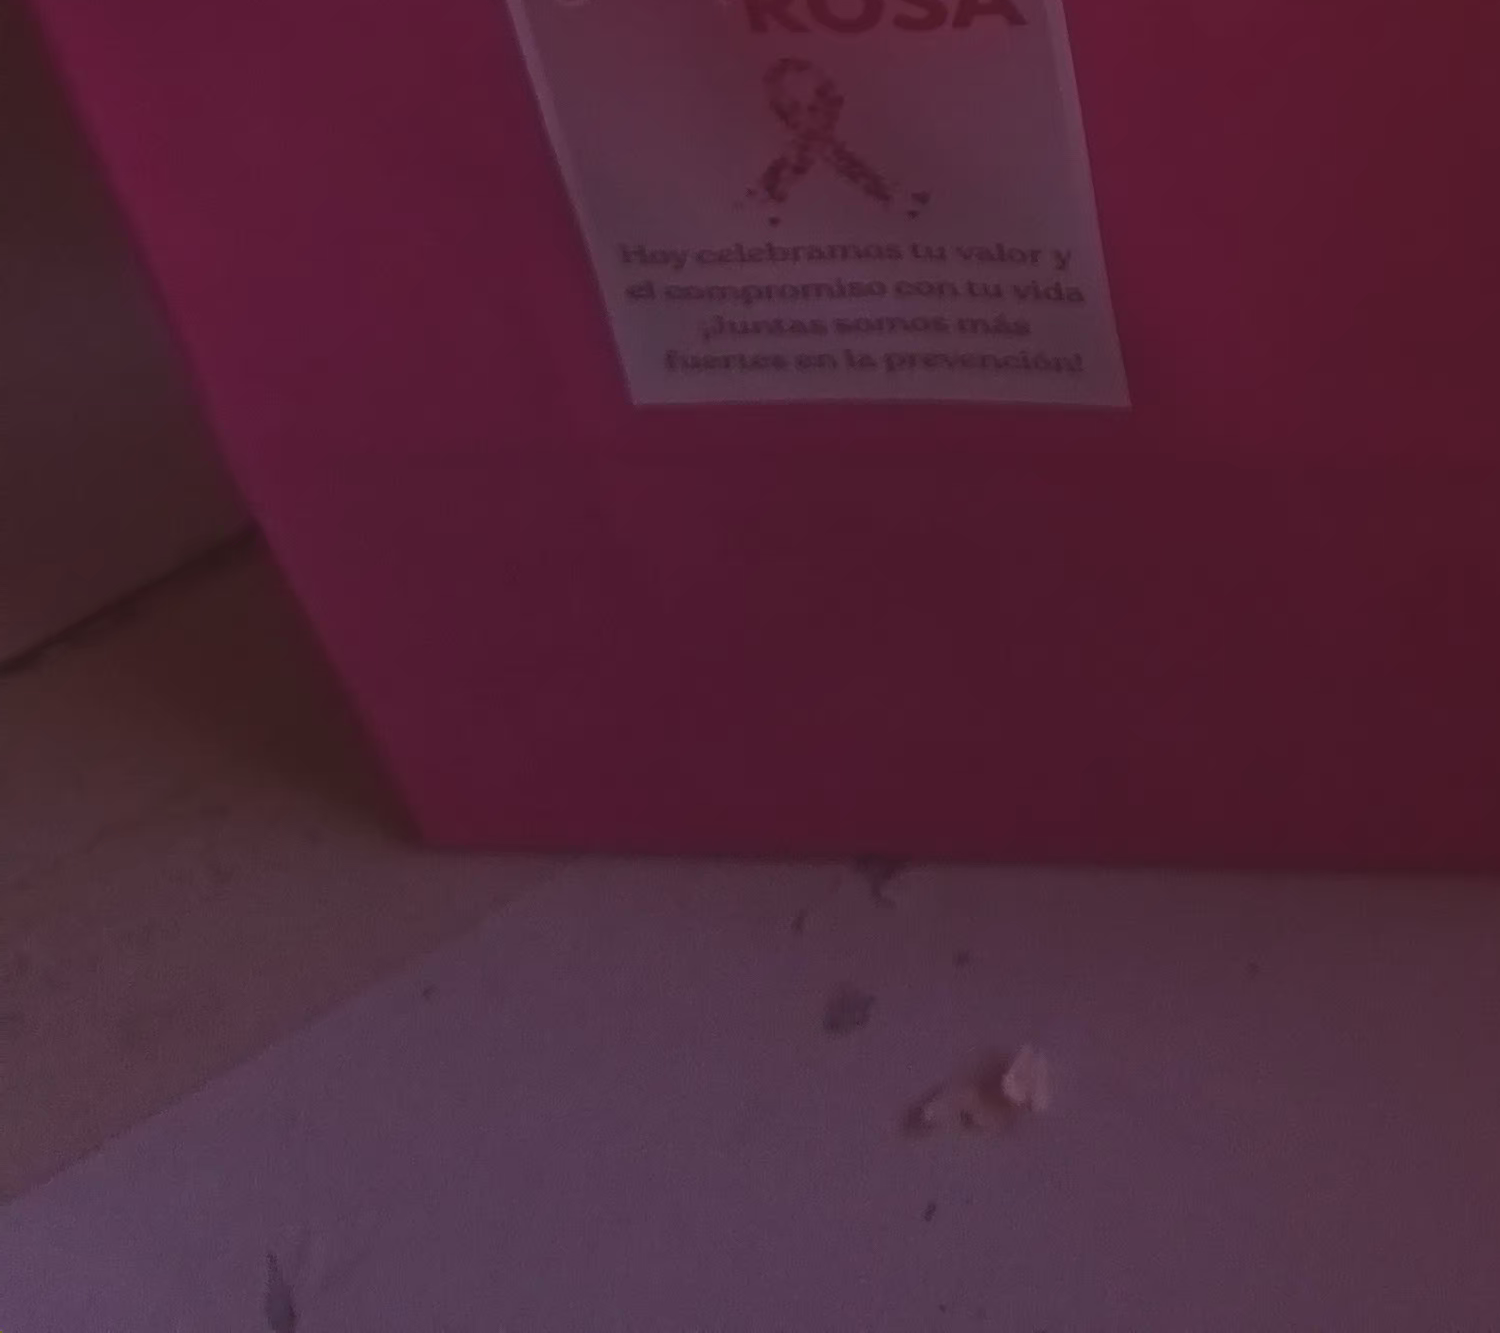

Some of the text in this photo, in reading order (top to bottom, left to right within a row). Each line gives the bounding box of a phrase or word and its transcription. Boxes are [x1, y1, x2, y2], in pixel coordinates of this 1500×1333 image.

[619, 242, 1073, 271] Hoy celebramos tu valor y
[626, 279, 1086, 307] el compromiso con tu vida
[833, 316, 951, 336] somos
[957, 314, 1032, 338] más
[795, 352, 838, 372] en
[843, 348, 877, 371] la
